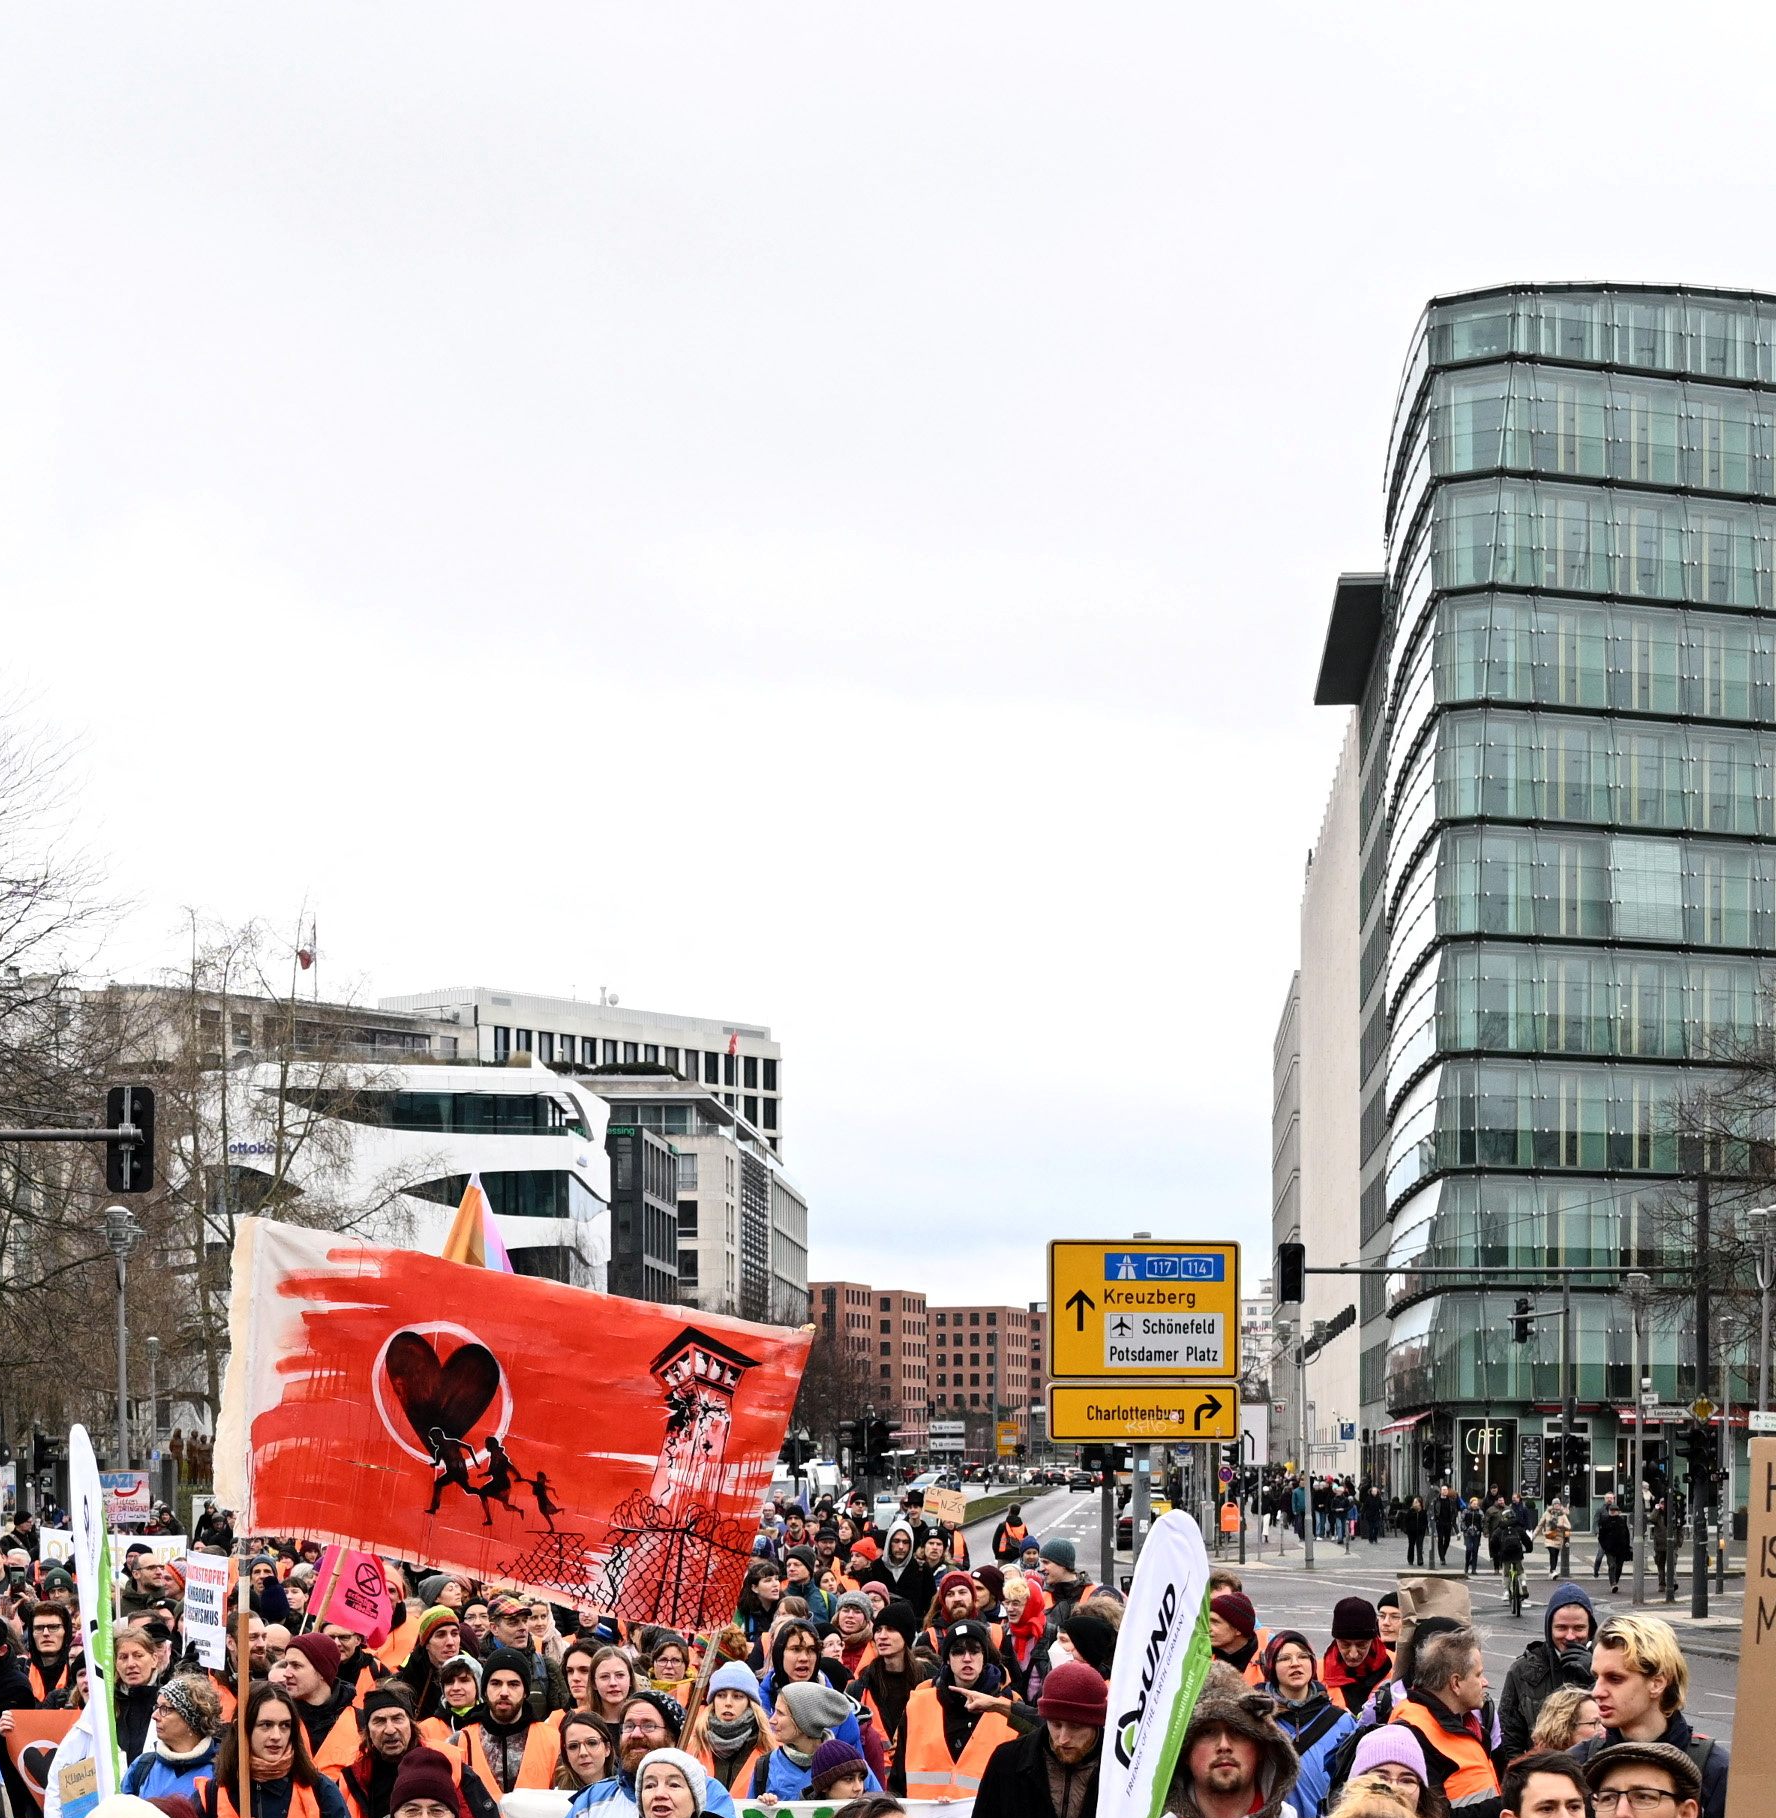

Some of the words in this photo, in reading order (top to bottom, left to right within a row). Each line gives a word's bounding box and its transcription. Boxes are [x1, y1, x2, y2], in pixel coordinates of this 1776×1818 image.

[607, 1127, 635, 1137] essing
[229, 1142, 291, 1154] ottobok
[1153, 1261, 1172, 1275] 117
[1187, 1261, 1207, 1275] 114
[1104, 1288, 1196, 1309] Kreuzberg
[1142, 1318, 1215, 1335] Schönefeld
[1109, 1346, 1179, 1362] Potsdamer
[1186, 1346, 1218, 1362] Platz
[1086, 1405, 1185, 1424] Charlottenburg
[1465, 1427, 1503, 1455] CAFE
[99, 1474, 133, 1488] NAZI
[1146, 1709, 1155, 1728] THE
[1153, 1670, 1168, 1702] EARTH
[1166, 1611, 1185, 1666] GERMANY
